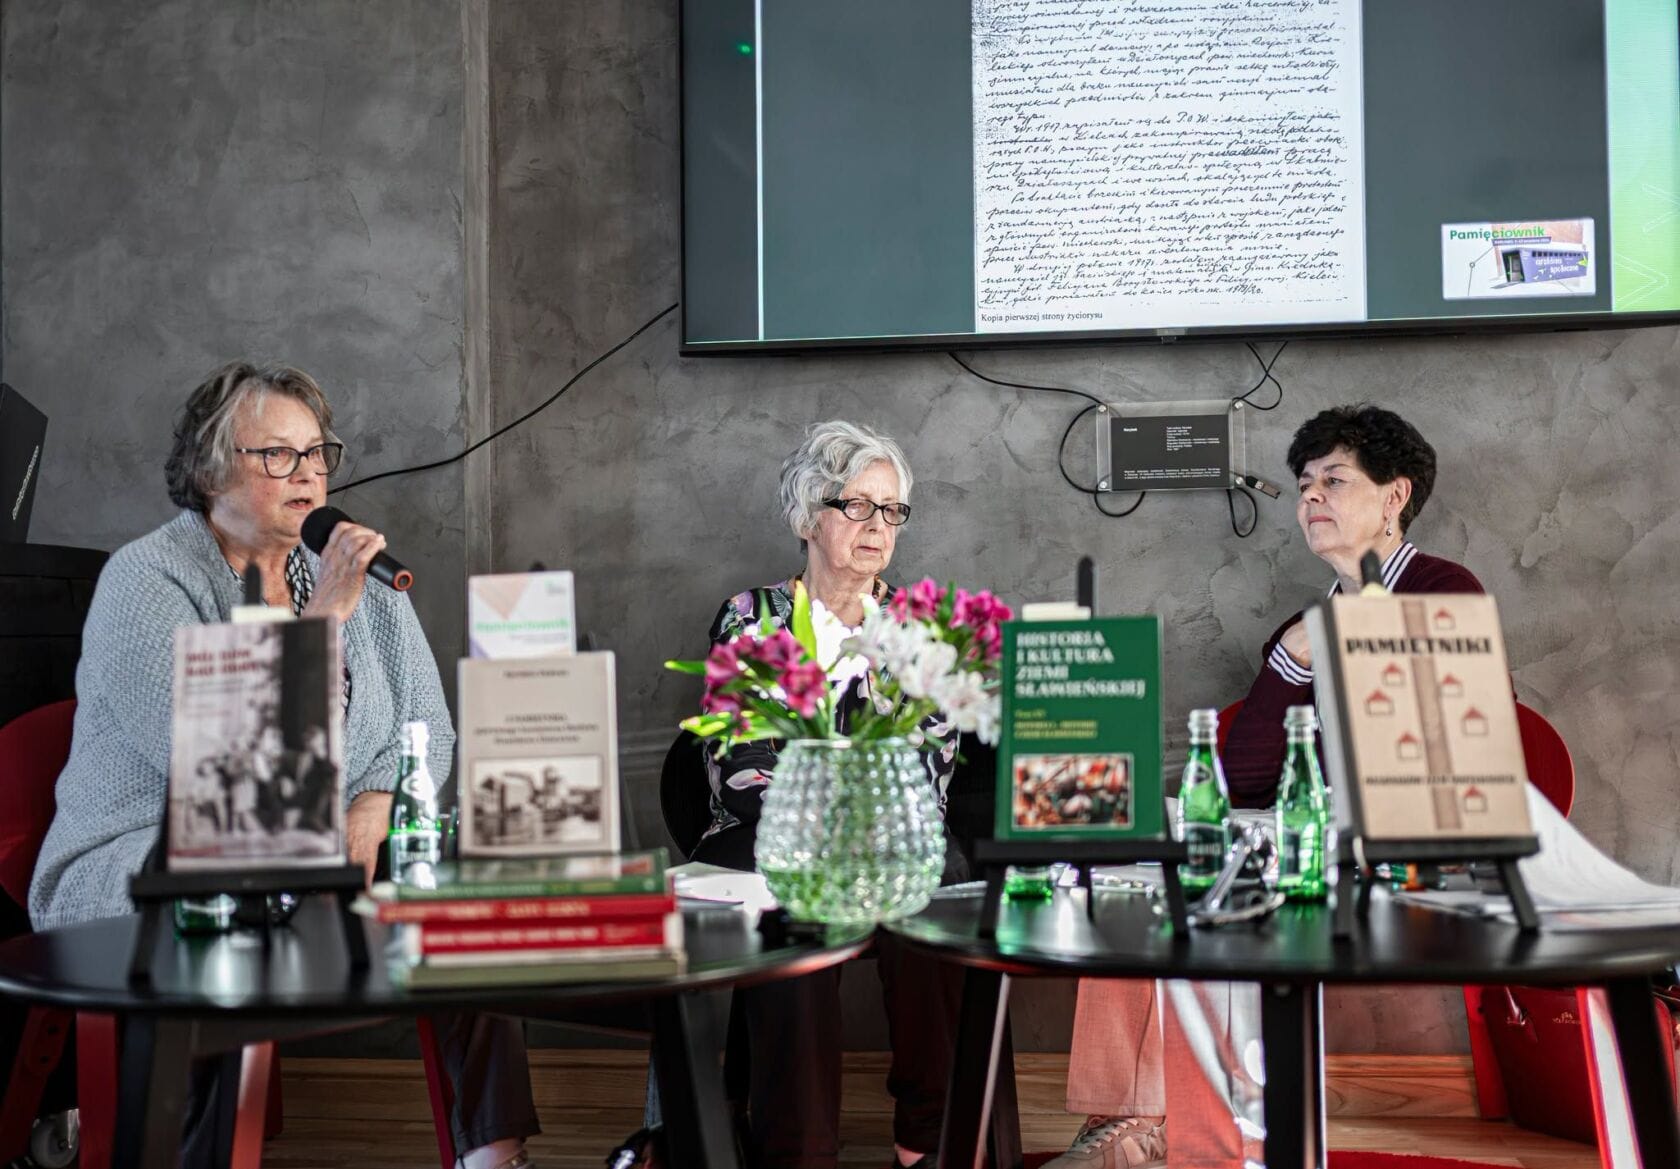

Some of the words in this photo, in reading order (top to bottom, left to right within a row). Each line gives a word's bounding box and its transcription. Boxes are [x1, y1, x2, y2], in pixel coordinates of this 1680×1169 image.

[1450, 226, 1545, 241] Pamięciownik
[981, 313, 1003, 322] Kopia
[1005, 312, 1040, 322] pierwszej
[1042, 311, 1064, 322] strony
[1017, 631, 1105, 647] HISTORIA
[1017, 649, 1024, 664] I
[1027, 647, 1115, 664] KULTURA
[1015, 665, 1069, 680] ZIEMI
